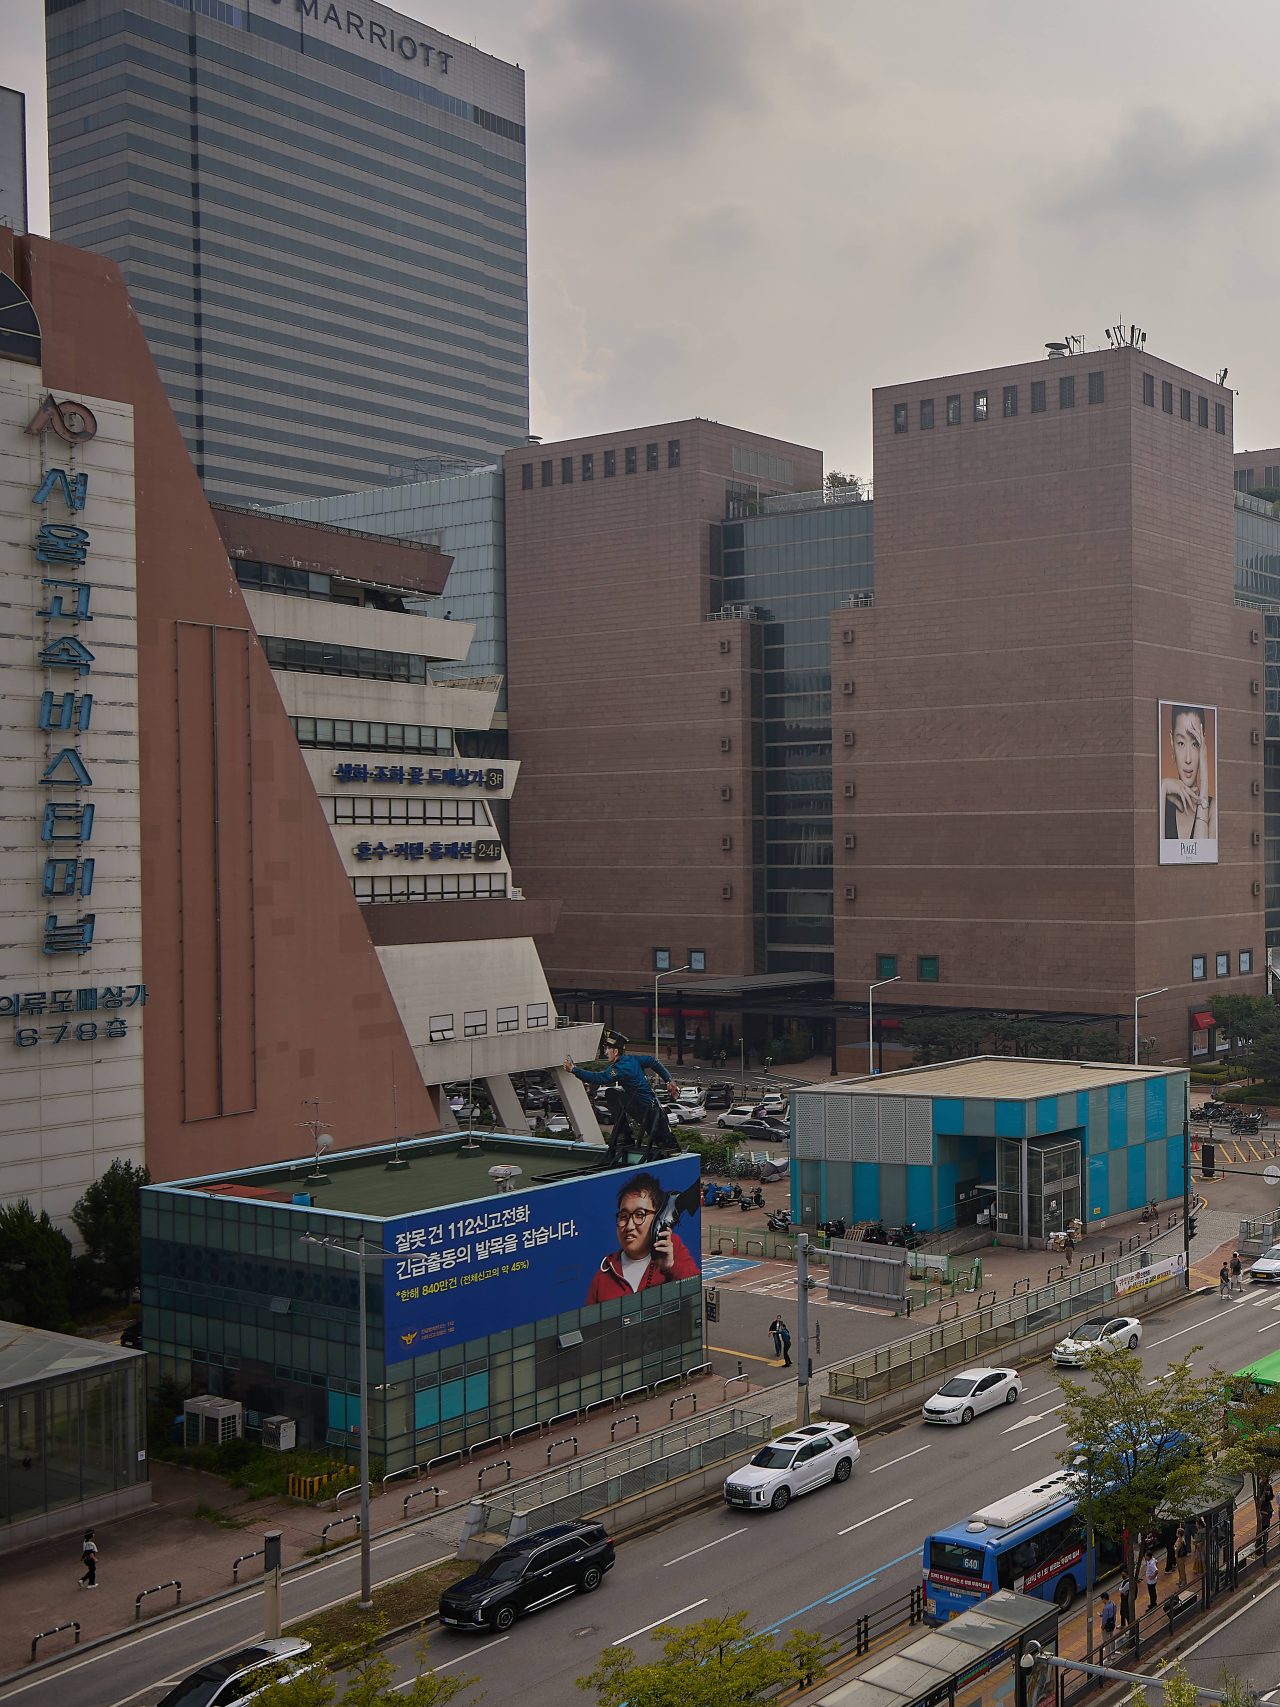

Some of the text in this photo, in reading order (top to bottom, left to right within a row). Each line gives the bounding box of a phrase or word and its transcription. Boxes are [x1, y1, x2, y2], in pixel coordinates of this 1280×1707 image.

[298, 0, 454, 75] MARRIOTT
[428, 768, 484, 787] 도매상가
[489, 772, 503, 786] 3F
[1180, 842, 1197, 855] PIAGET
[0, 984, 149, 1017] 의류도매상가
[395, 1204, 531, 1254] 잘못 건 112신고전화
[396, 1219, 579, 1281] 긴급출동의 발목을 잡습니다.
[422, 1277, 458, 1298] 840만건
[460, 1266, 500, 1288] (전체신고의
[501, 1263, 510, 1276] 약
[511, 1259, 530, 1274] 45%)
[964, 1557, 978, 1570] 640
